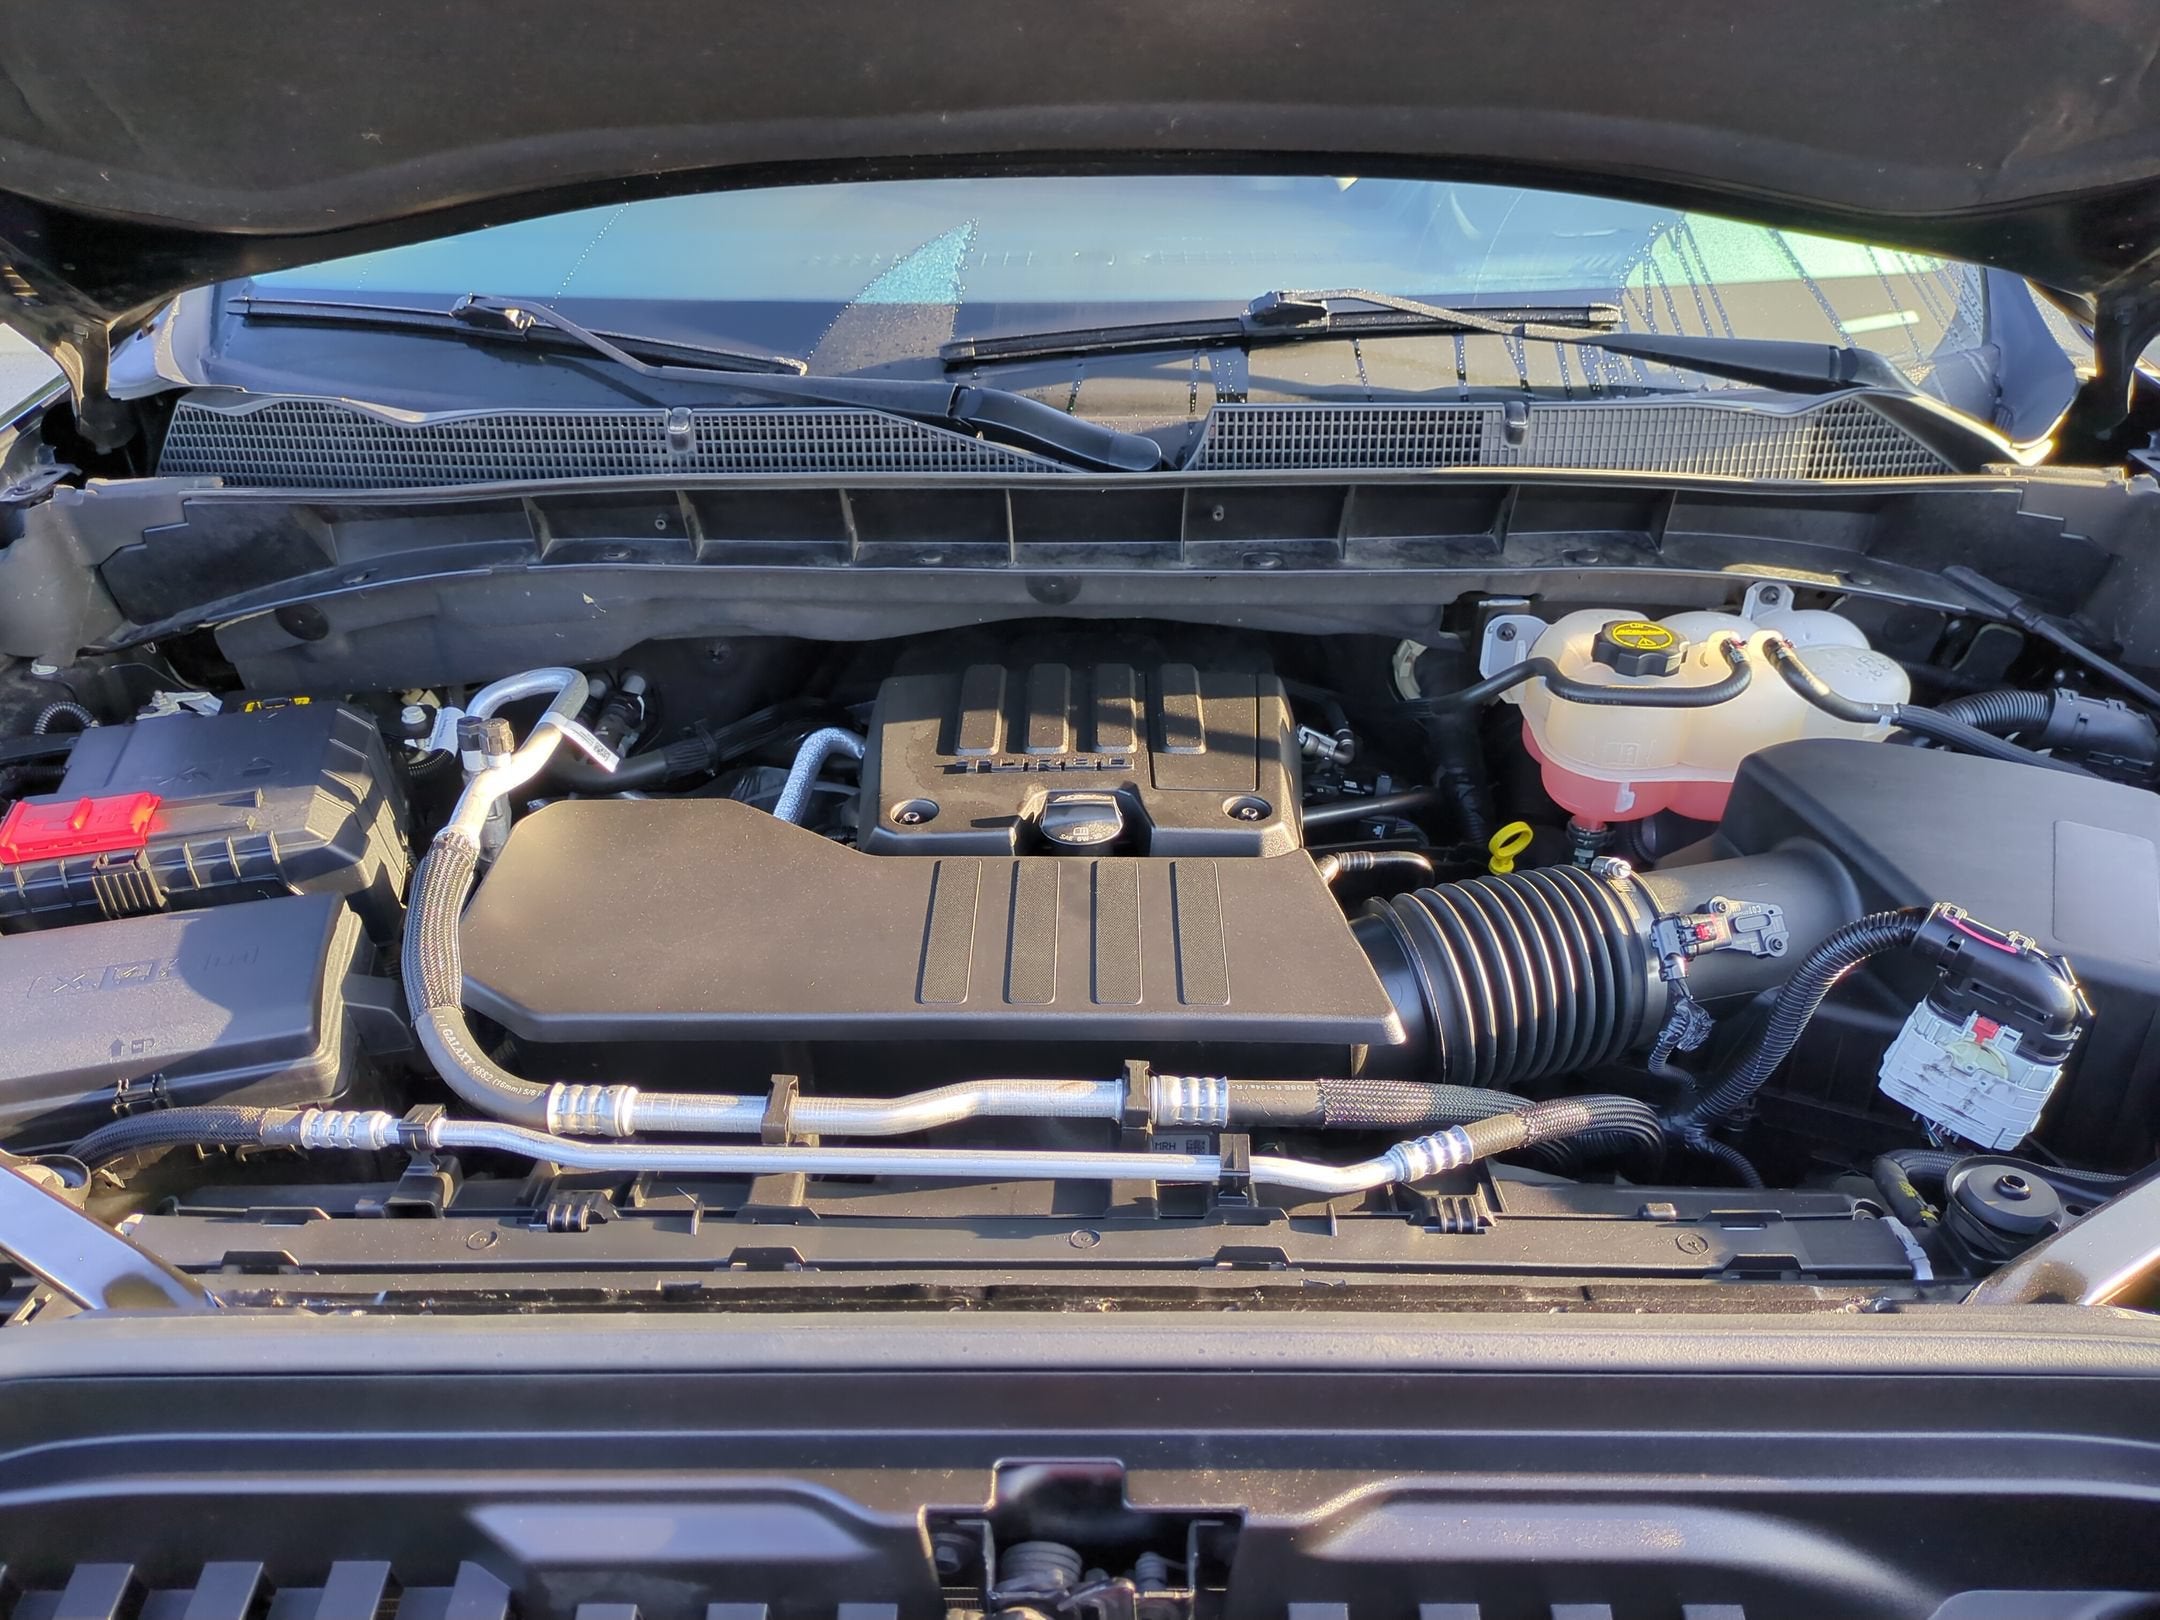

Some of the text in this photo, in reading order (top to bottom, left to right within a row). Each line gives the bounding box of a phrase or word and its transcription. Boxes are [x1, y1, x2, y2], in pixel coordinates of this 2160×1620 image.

[442, 1028, 476, 1067] GALAXY
[472, 1064, 494, 1082] 4882
[492, 1077, 522, 1096] (16mm)
[1154, 1141, 1177, 1151] MRH
